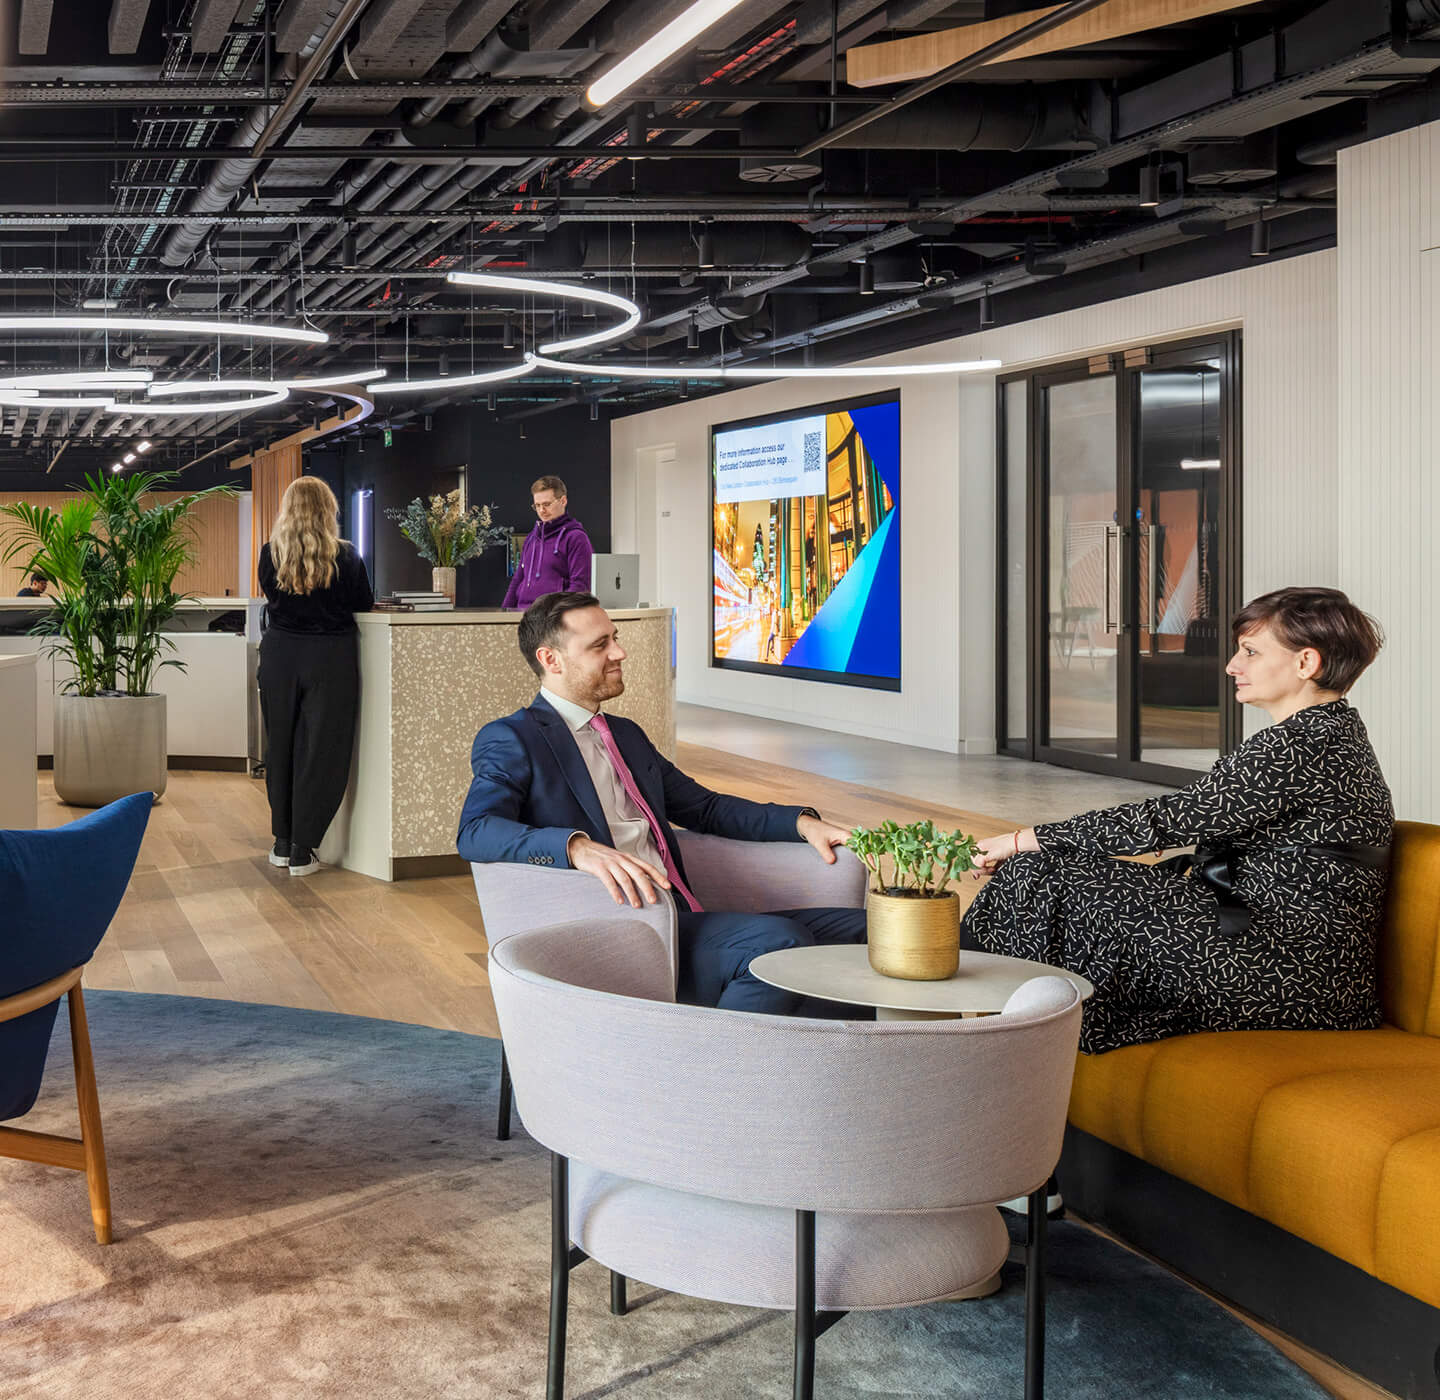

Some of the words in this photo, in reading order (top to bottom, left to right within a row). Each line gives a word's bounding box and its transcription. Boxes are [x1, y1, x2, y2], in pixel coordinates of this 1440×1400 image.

[738, 447, 760, 457] information
[761, 445, 776, 453] access
[719, 462, 738, 471] dedicated
[739, 459, 766, 468] Collaboration
[767, 457, 776, 465] Hub
